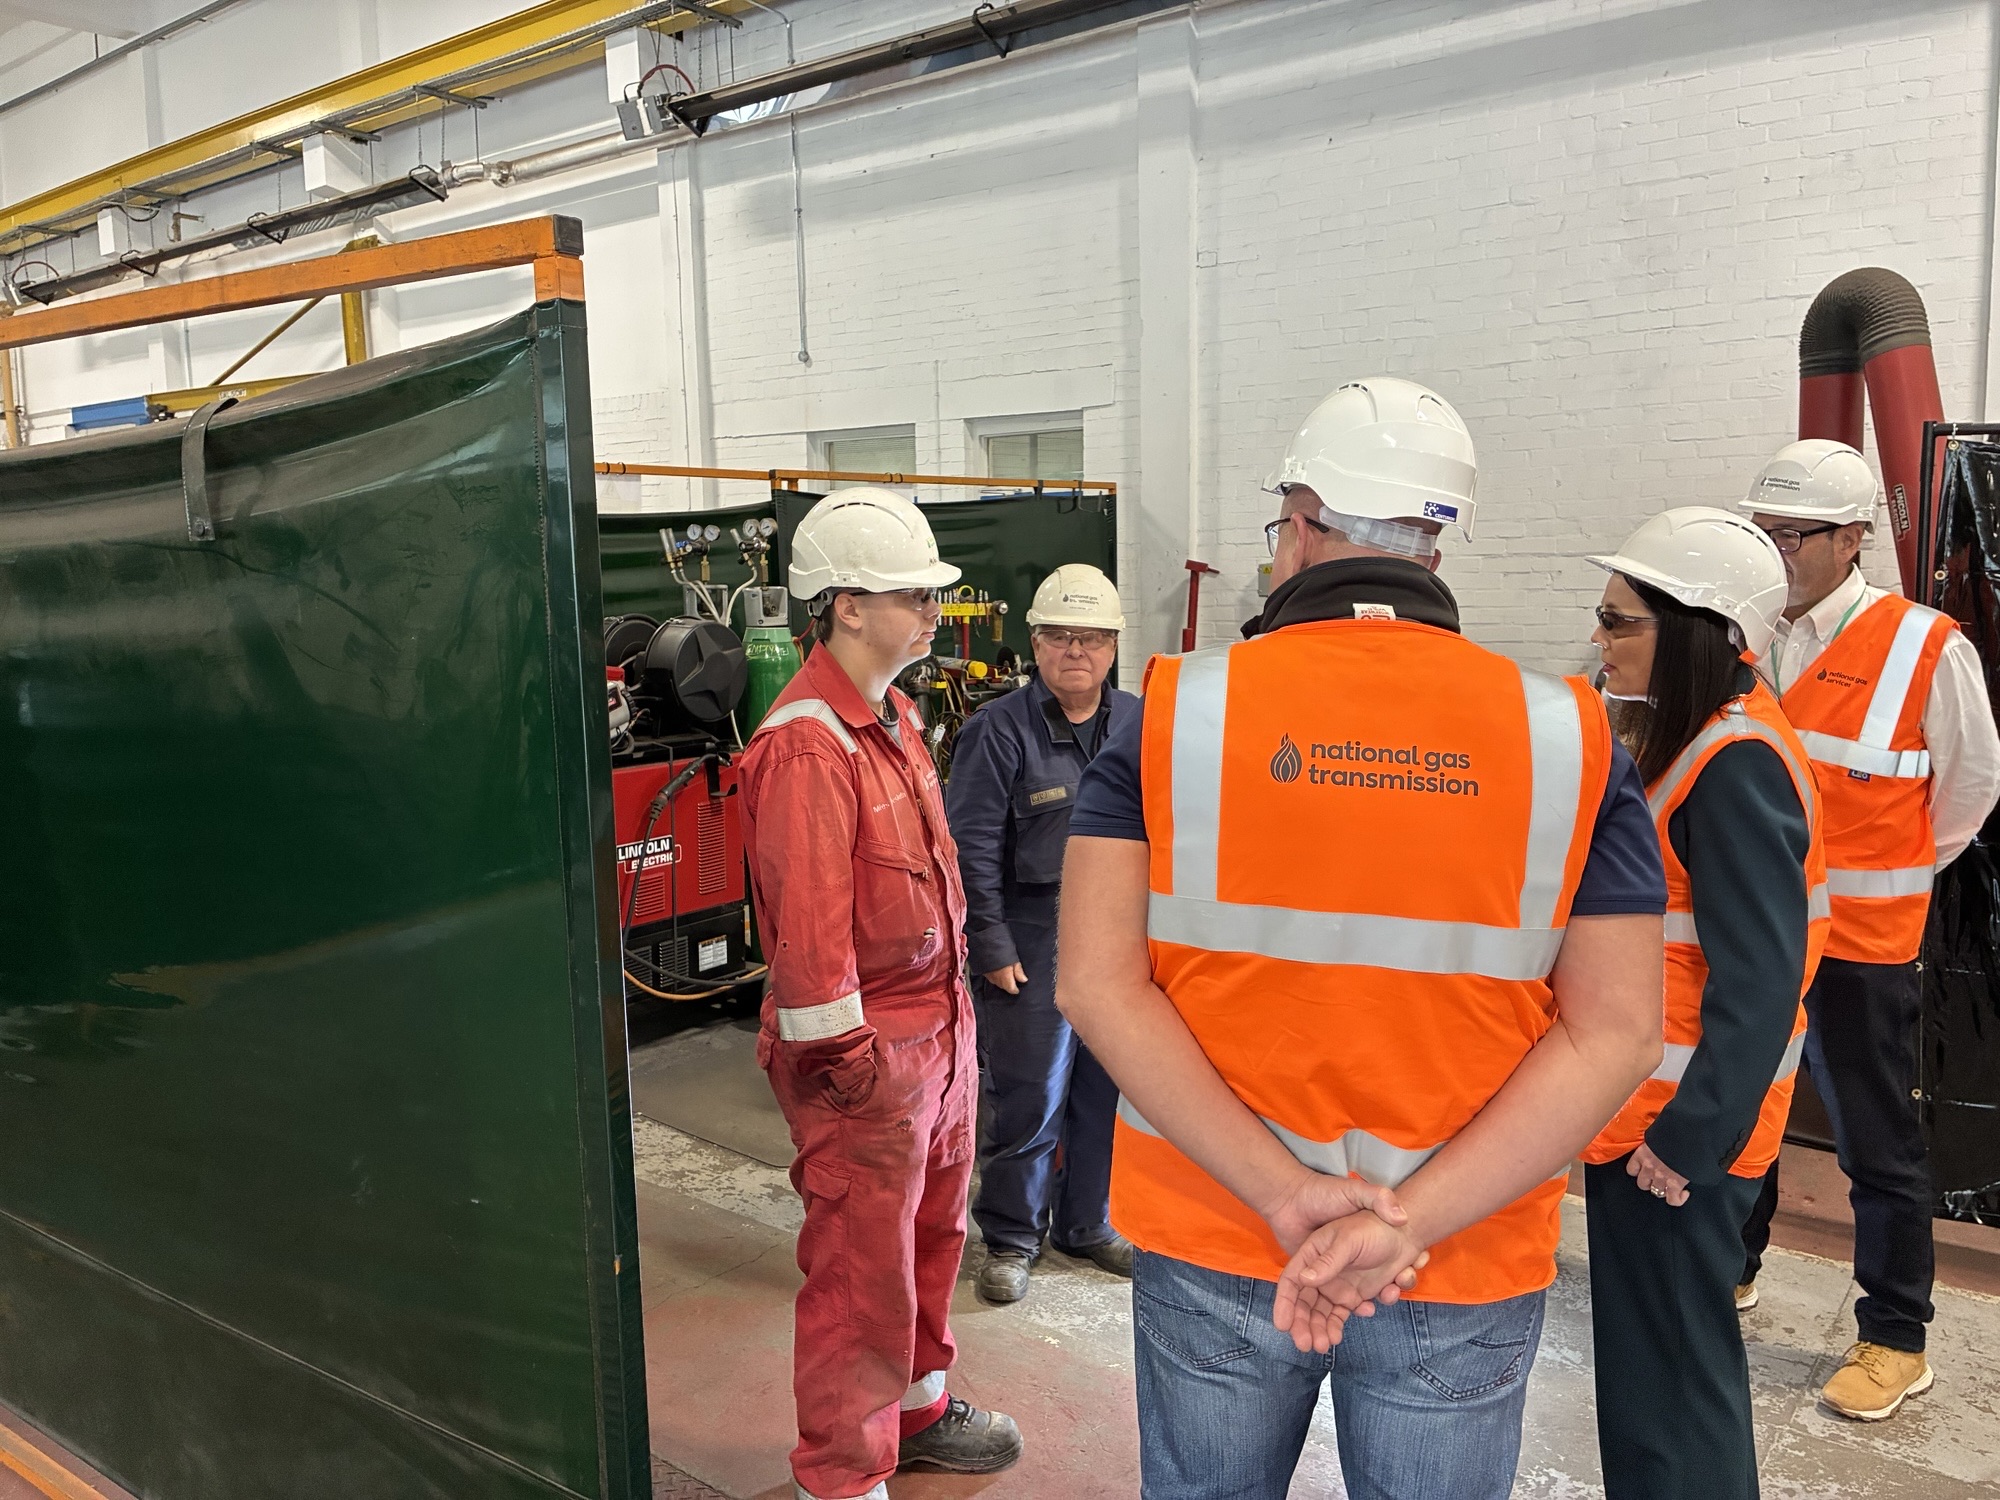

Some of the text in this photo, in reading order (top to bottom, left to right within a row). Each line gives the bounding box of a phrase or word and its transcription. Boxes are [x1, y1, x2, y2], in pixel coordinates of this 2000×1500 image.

[1895, 487, 1909, 530] LINCOLN
[1826, 678, 1851, 688] services
[1829, 671, 1868, 686] national gas
[1310, 740, 1471, 773] national gas
[1308, 763, 1479, 797] transmission
[618, 838, 670, 861] LINCOLN
